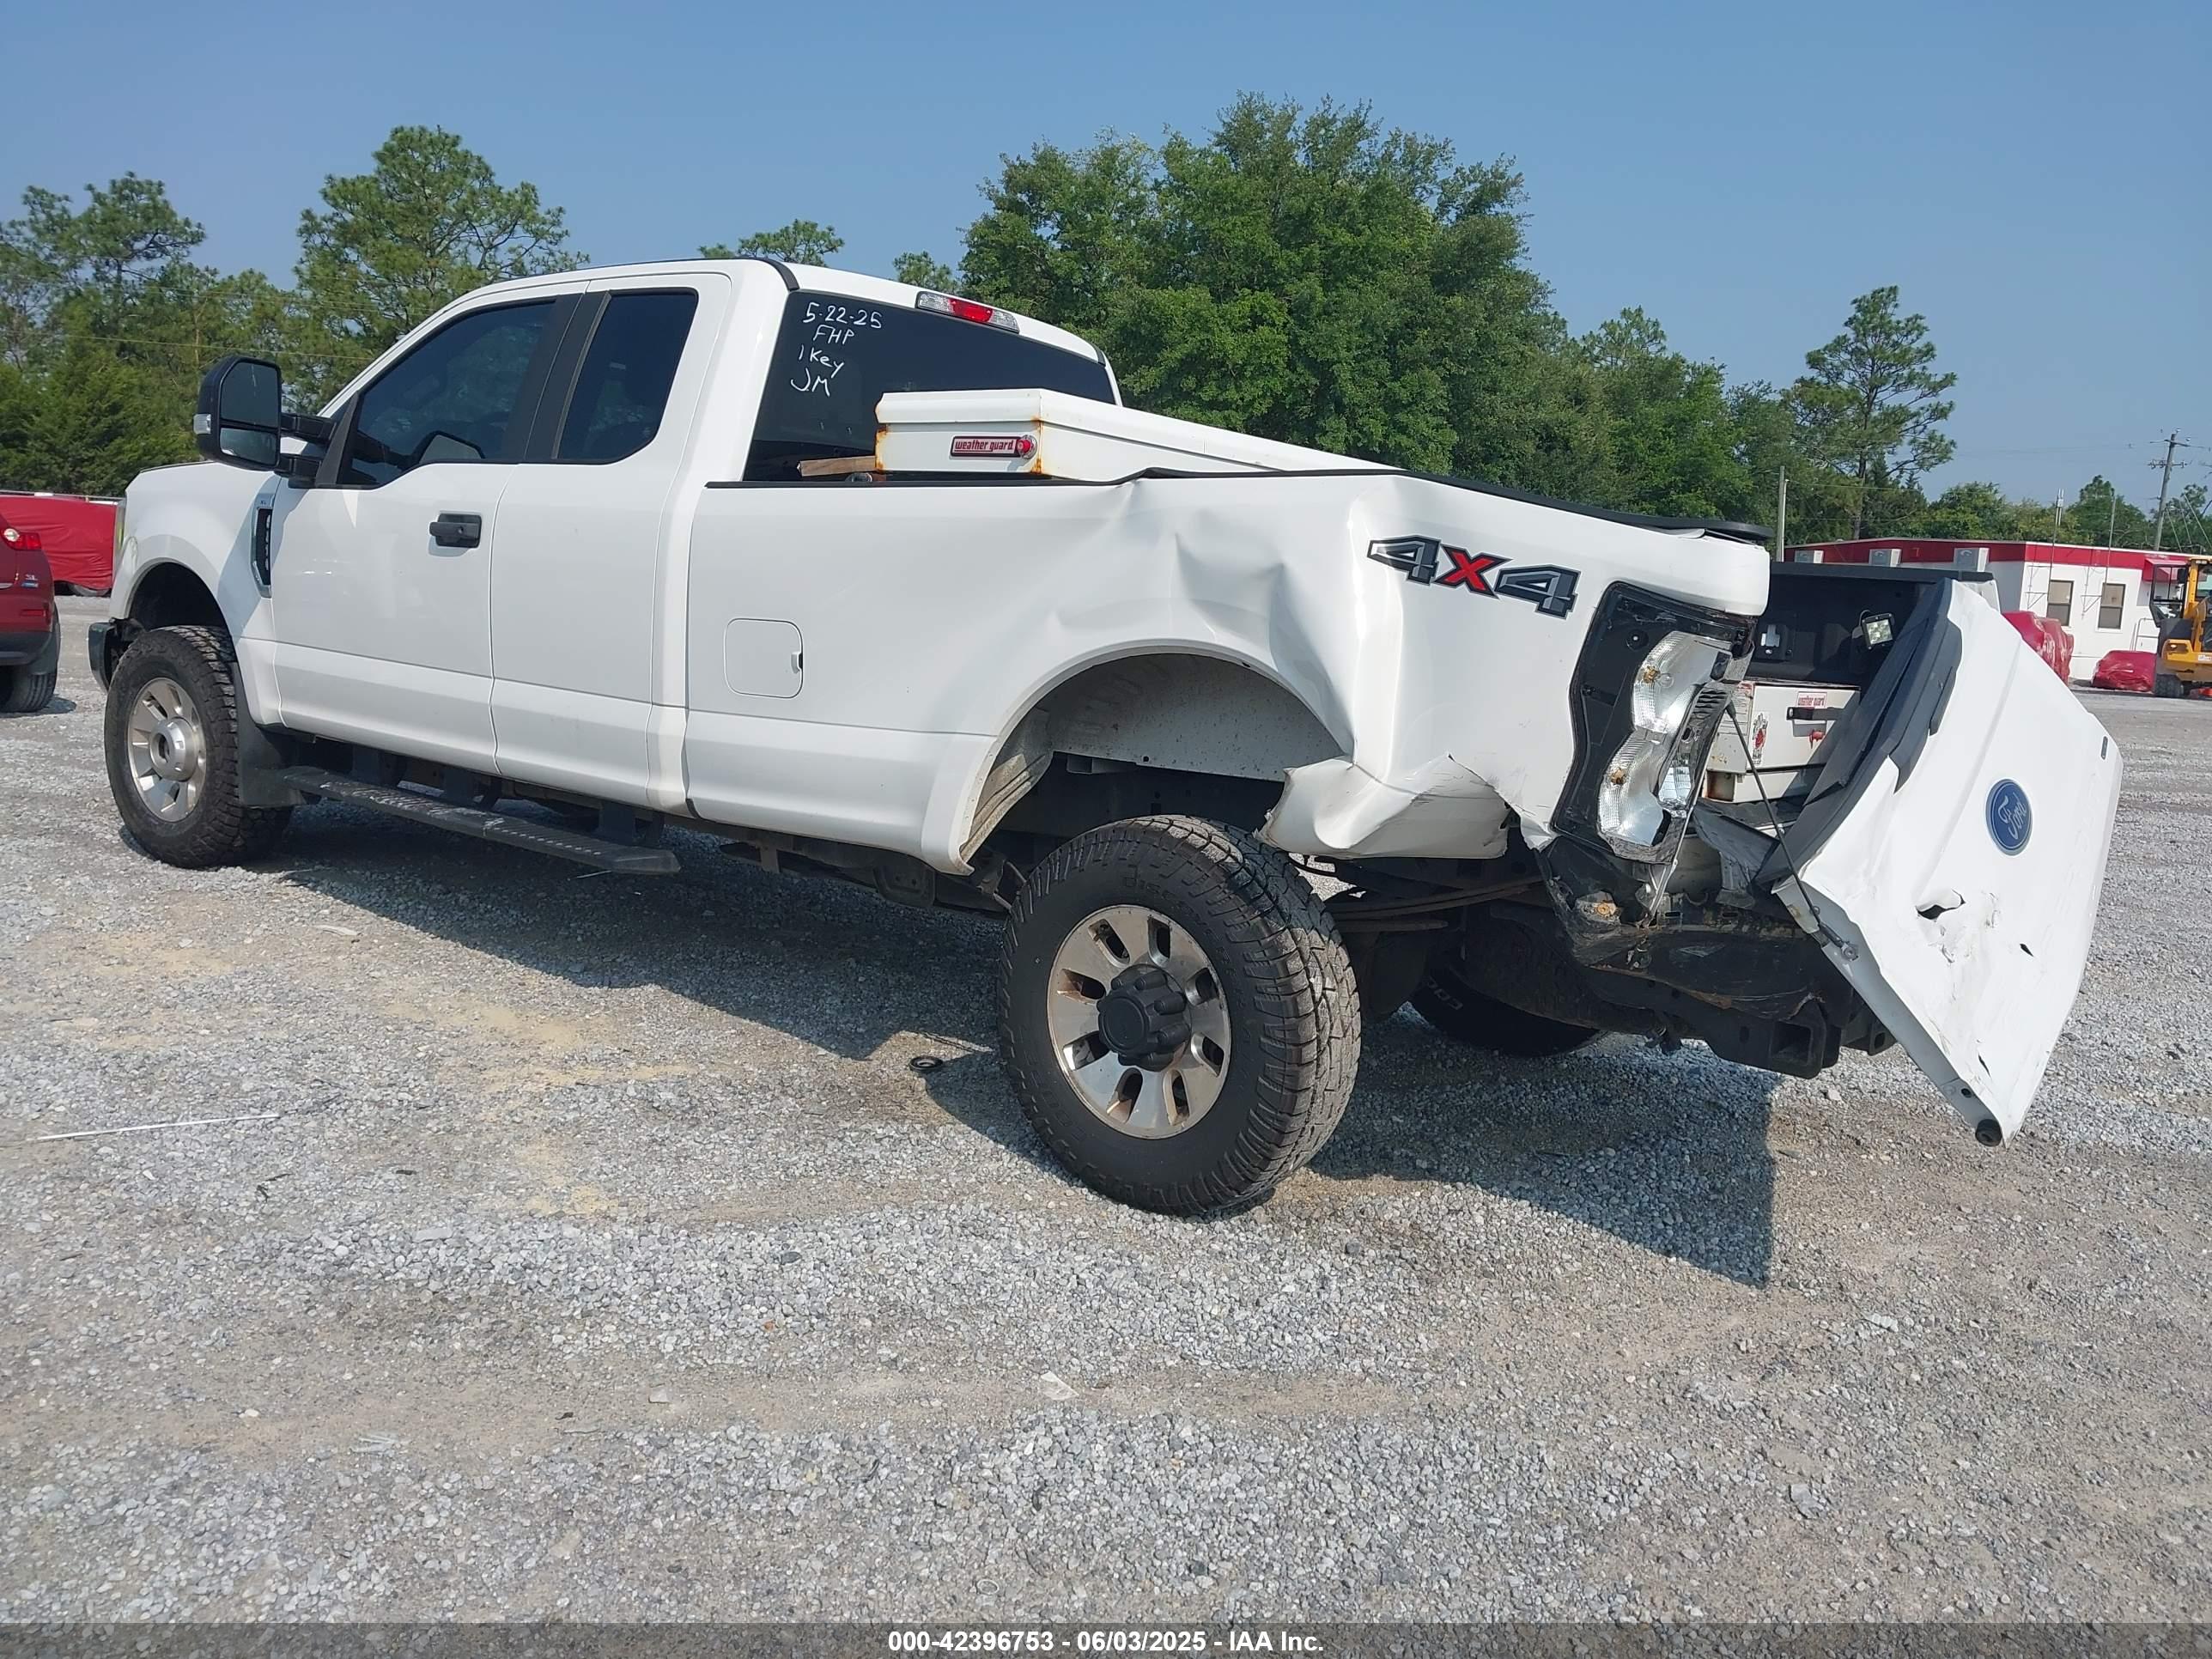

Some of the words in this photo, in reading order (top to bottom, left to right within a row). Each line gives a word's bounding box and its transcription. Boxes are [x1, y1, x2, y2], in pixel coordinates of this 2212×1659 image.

[803, 301, 882, 329] 5-22-25
[812, 324, 855, 345] FHP
[810, 346, 845, 379] Key
[954, 439, 988, 450] weather
[988, 439, 1014, 453] guard
[1997, 791, 2027, 840] Ford
